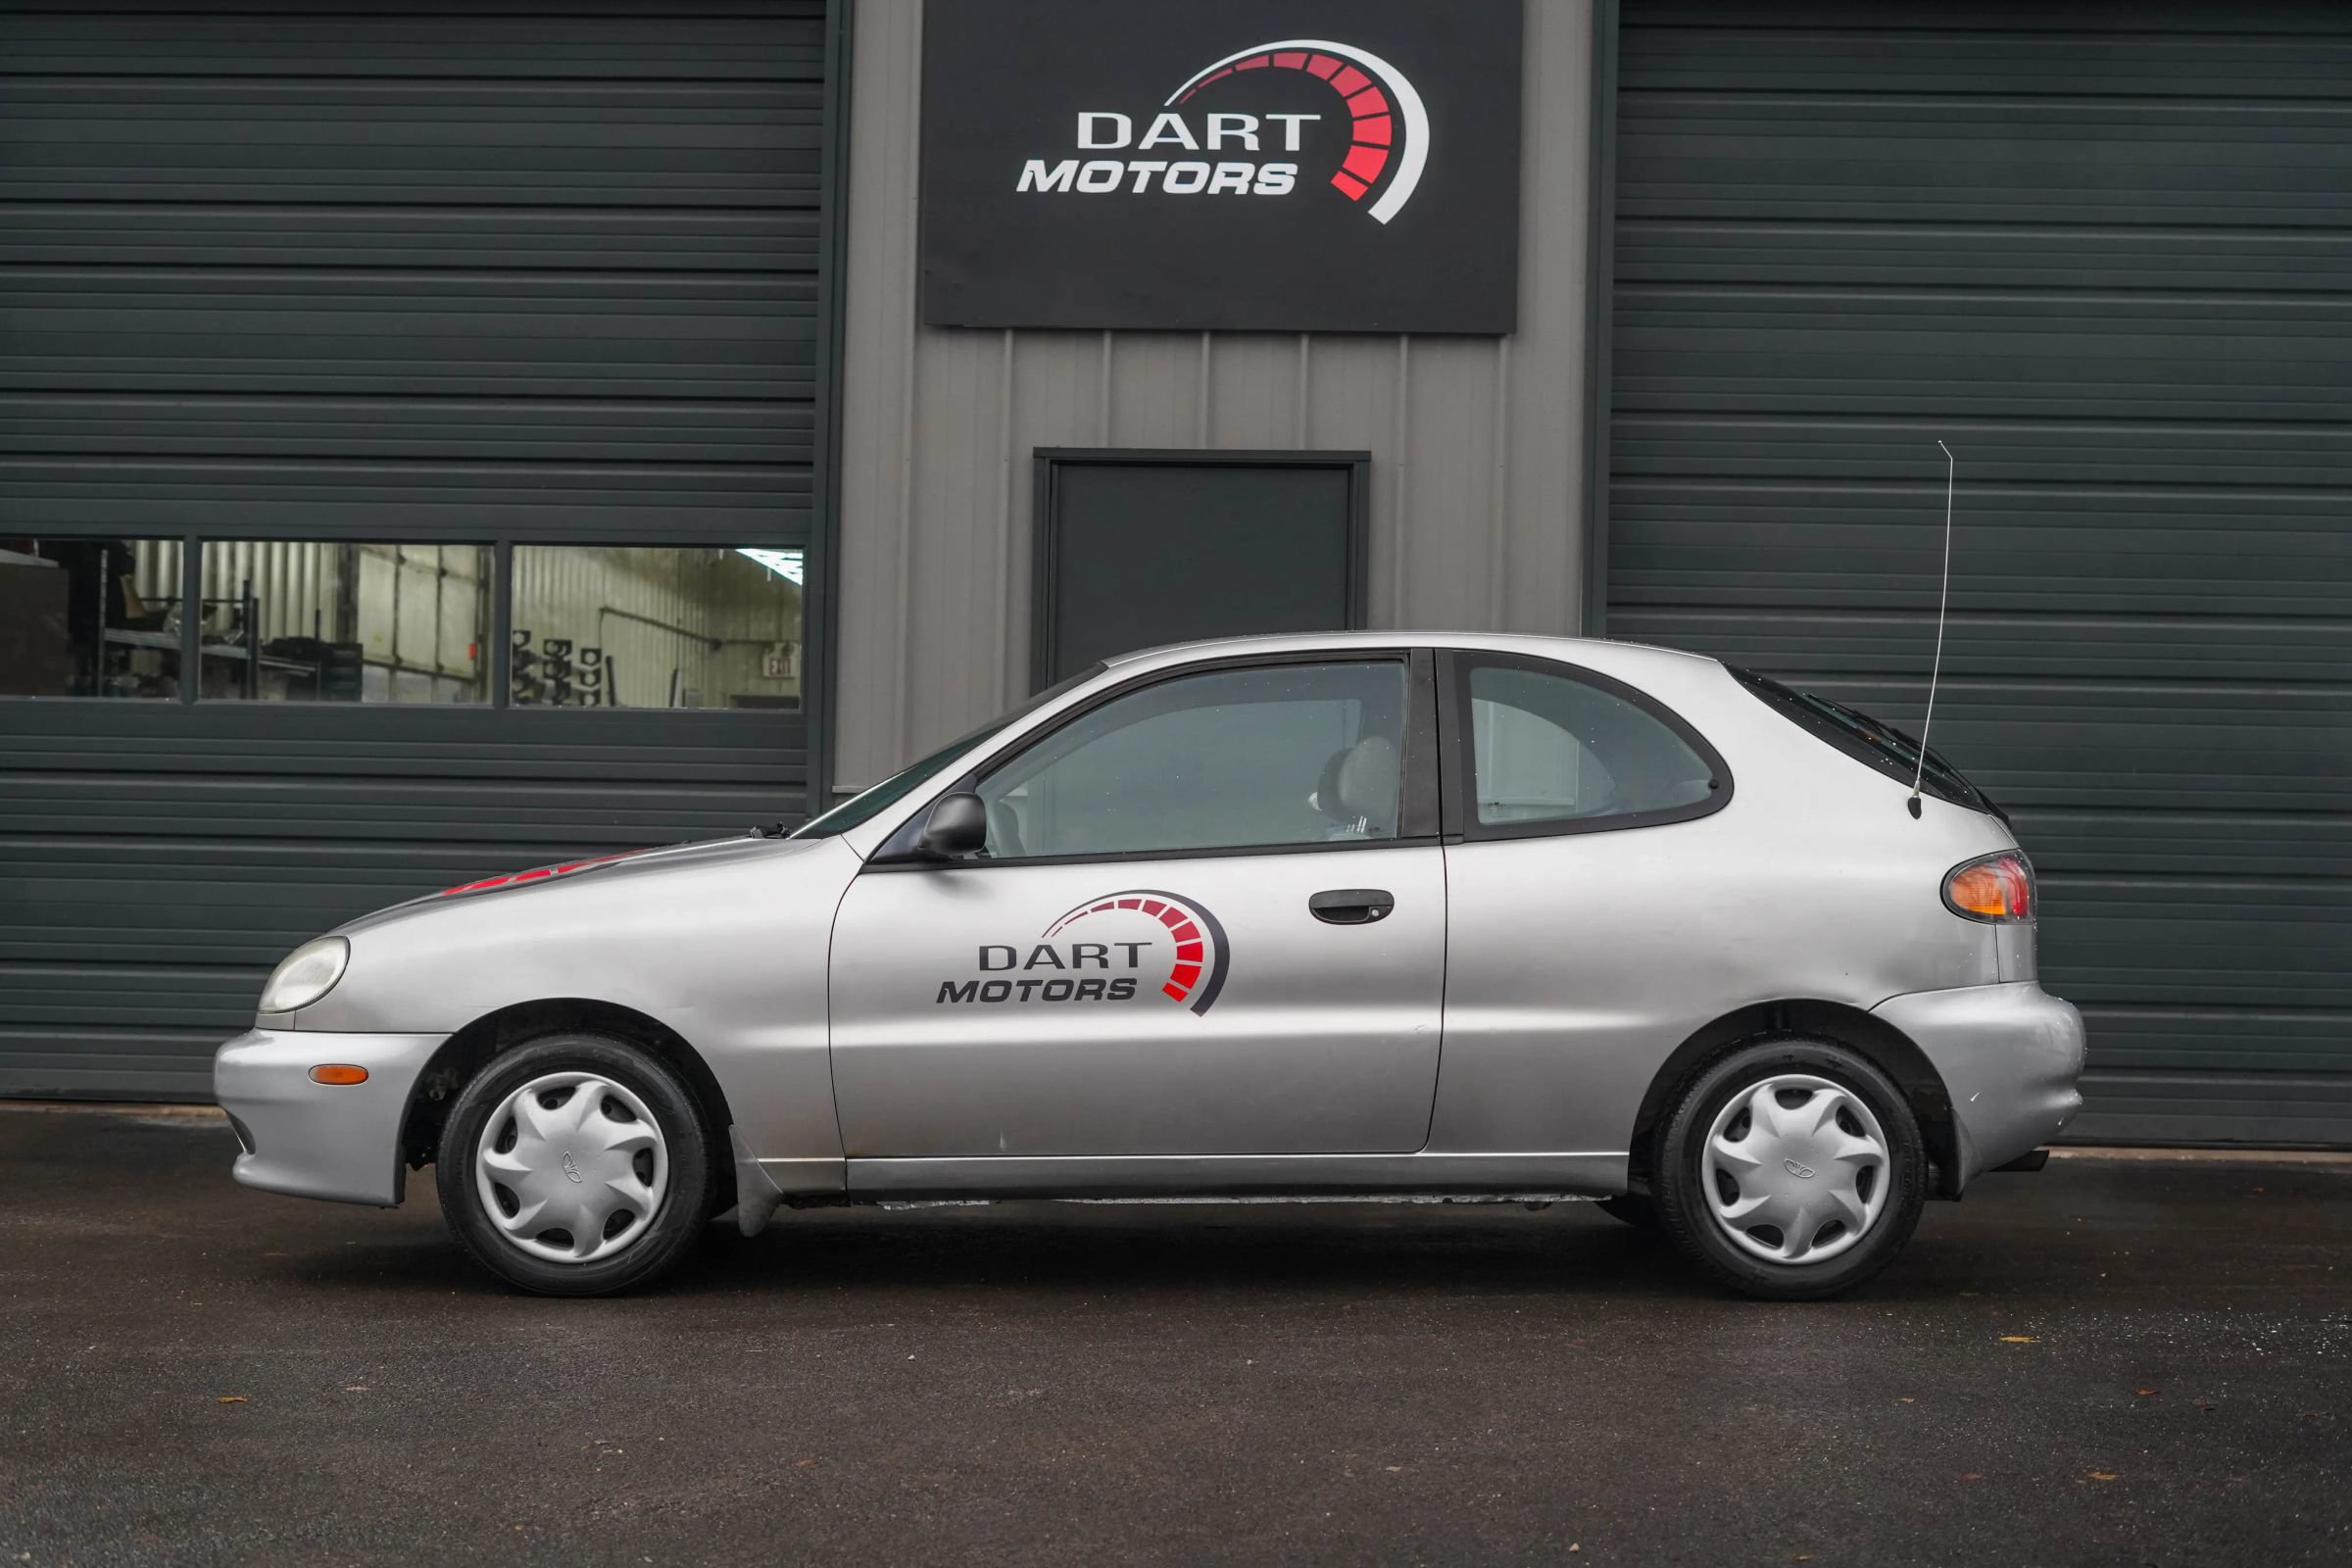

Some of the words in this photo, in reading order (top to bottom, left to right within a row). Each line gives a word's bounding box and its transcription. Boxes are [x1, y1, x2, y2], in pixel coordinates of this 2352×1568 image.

[1078, 113, 1321, 151] DART
[1016, 160, 1298, 195] MOTORS
[979, 942, 1152, 971] DART
[936, 978, 1138, 1004] MOTORS
